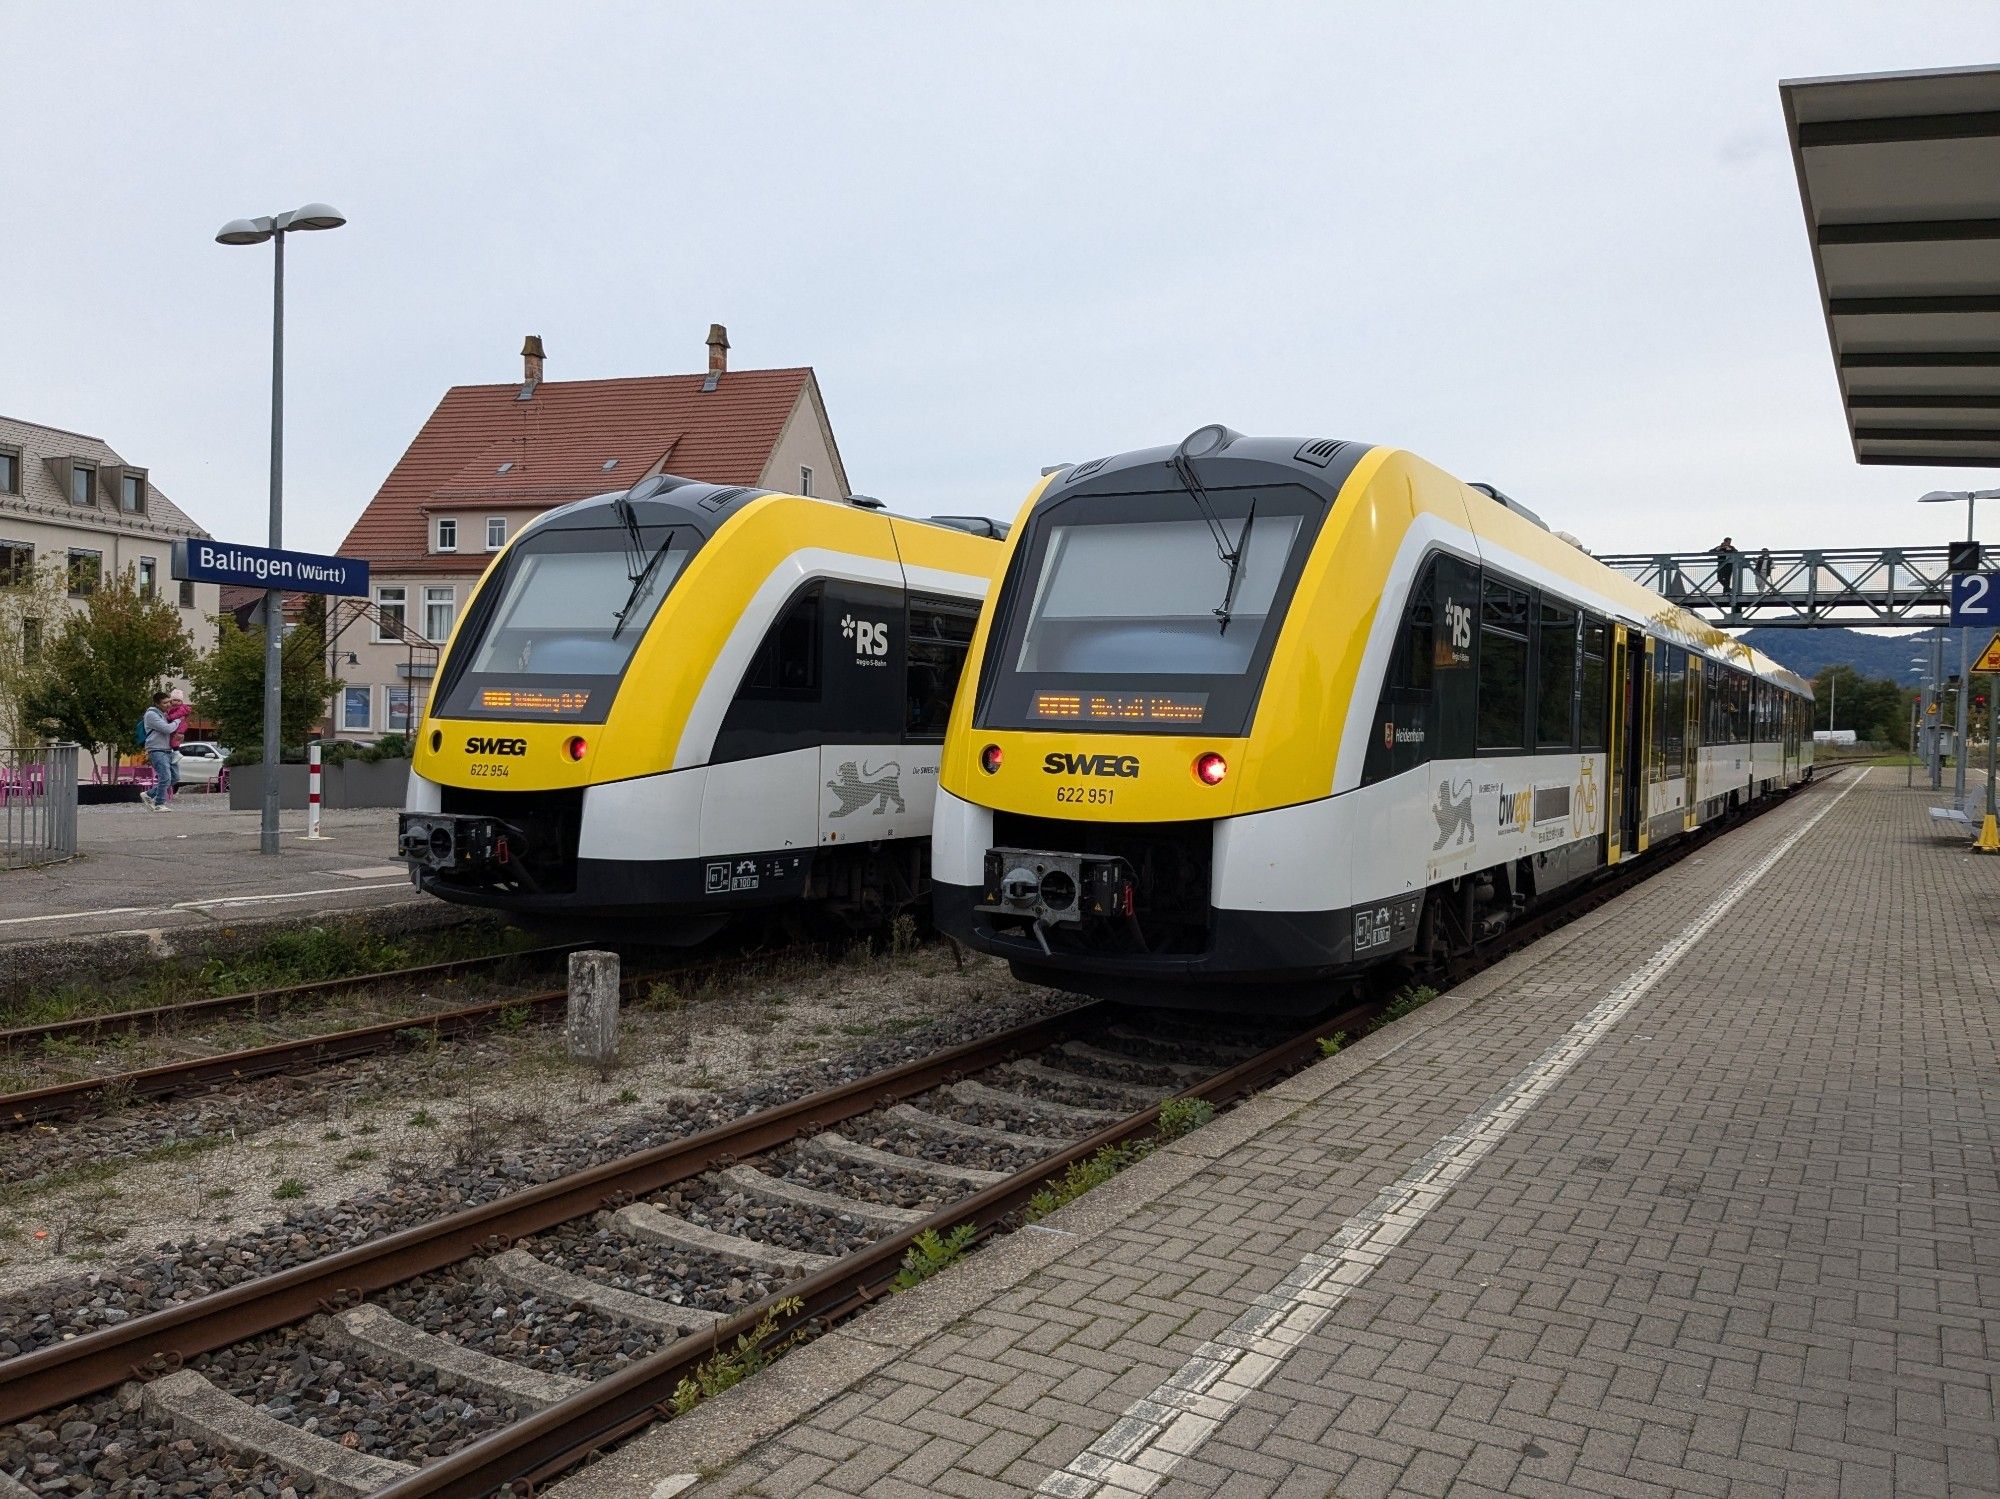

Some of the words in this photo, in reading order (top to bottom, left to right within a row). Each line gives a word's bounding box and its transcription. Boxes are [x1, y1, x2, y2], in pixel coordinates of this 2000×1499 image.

[200, 547, 293, 579] Balingen
[297, 562, 346, 584] (Württ)
[1959, 574, 1989, 614] 2
[856, 620, 888, 656] RS
[1452, 605, 1471, 649] RS
[464, 737, 527, 757] SWEG
[1042, 752, 1140, 778] SWEG
[470, 763, 488, 776] 622
[490, 765, 509, 777] 954
[1057, 787, 1085, 803] 622
[1088, 788, 1114, 805] 951
[1499, 782, 1532, 833] bwegt
